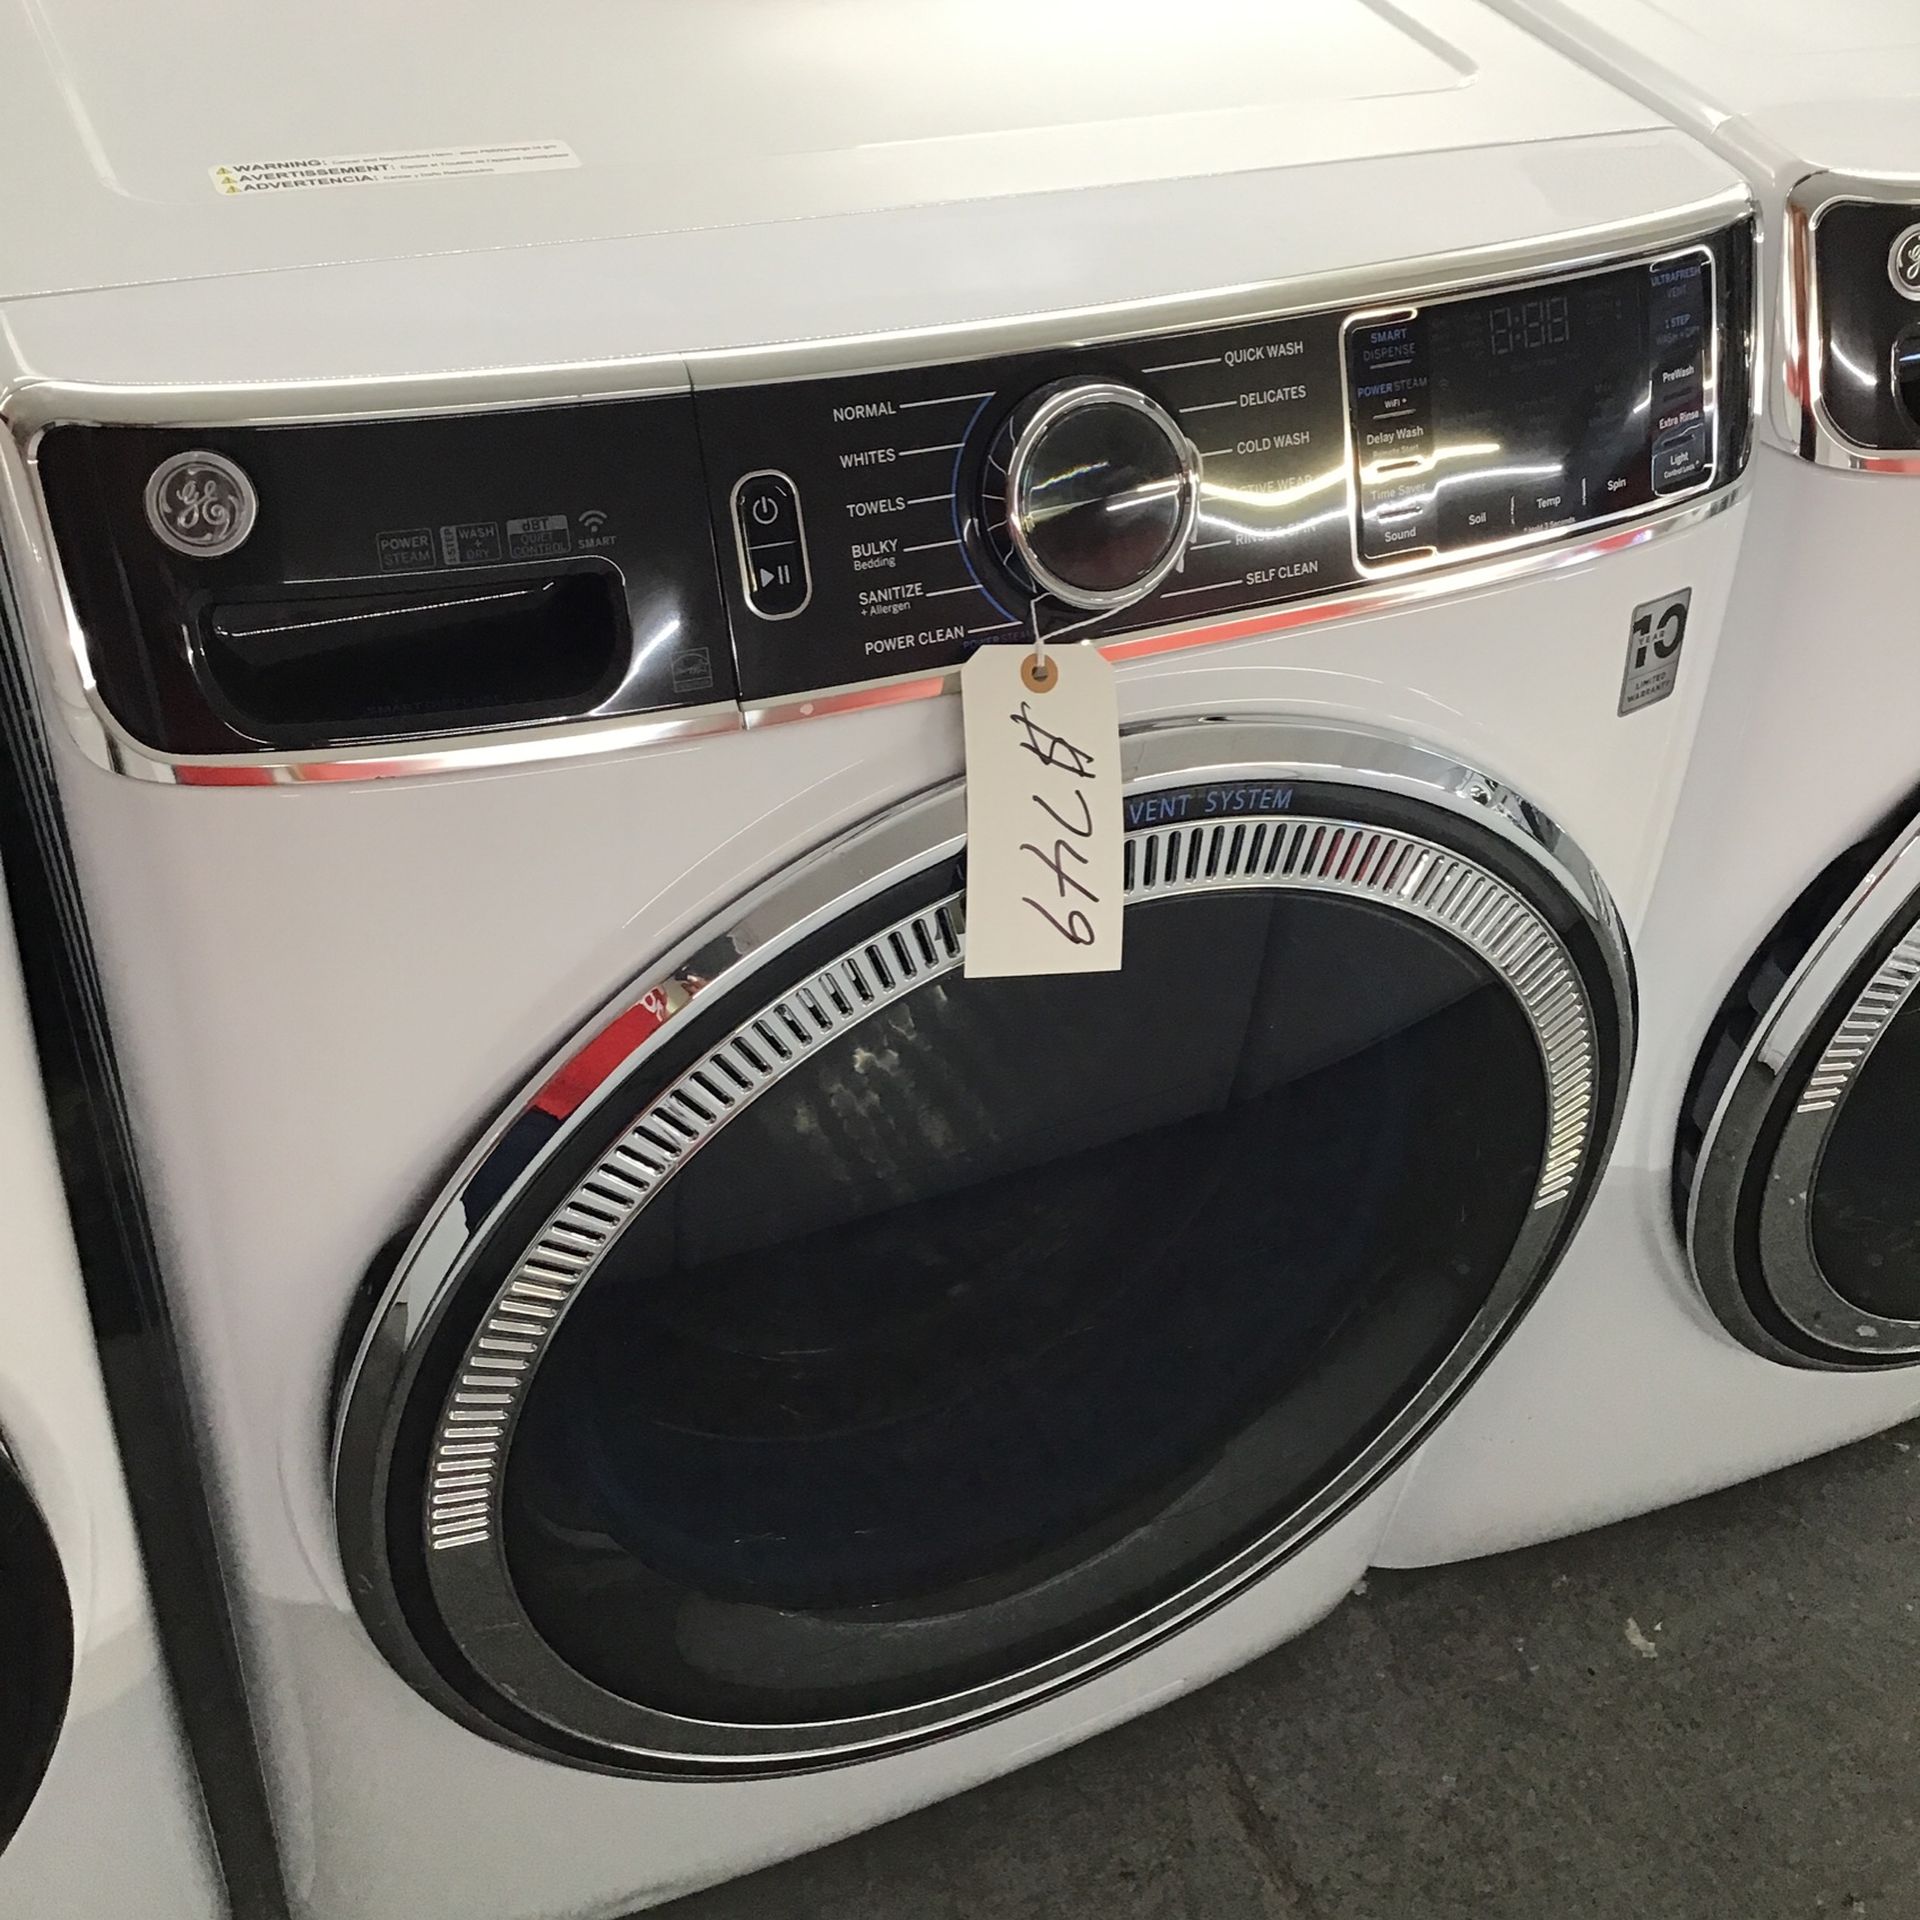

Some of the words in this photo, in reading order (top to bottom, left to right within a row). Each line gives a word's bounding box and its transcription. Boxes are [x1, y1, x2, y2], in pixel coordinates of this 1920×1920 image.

[233, 159, 327, 172] WARNING:
[239, 164, 395, 182] AVERTISSEMENT:
[244, 175, 378, 191] ADVERTENCIA:
[1370, 328, 1407, 344] SMART
[1224, 347, 1265, 367] QUICK
[1266, 341, 1304, 358] WASH
[1363, 343, 1416, 361] DISPENSE
[1239, 385, 1307, 407] DELICATES
[833, 401, 897, 422] NORMAL
[1659, 416, 1679, 430] Extra
[1237, 438, 1271, 455] COLD
[1273, 431, 1310, 449] WASH
[1367, 431, 1395, 445] Delay
[1397, 426, 1424, 440] Wash
[840, 448, 896, 469] WHITES
[1670, 451, 1689, 466] Light
[1607, 477, 1627, 491] Spin
[1371, 488, 1396, 501] Time
[1536, 496, 1561, 508] Temp
[846, 497, 906, 518] TOWELS
[1468, 512, 1487, 525] Soil
[459, 526, 495, 539] WASH
[1385, 527, 1416, 542] Sound
[380, 535, 429, 550] POWER
[578, 535, 617, 549] SMART
[852, 539, 898, 559] BULKY
[383, 550, 431, 566] STEAM
[854, 556, 896, 571] Bedding
[1246, 568, 1275, 585] SELF
[1278, 561, 1318, 580] CLEAN
[858, 583, 924, 606] SANITIZE
[870, 601, 911, 617] Allergen
[865, 636, 915, 655] POWER
[919, 626, 965, 647] CLEAN
[1633, 603, 1687, 669] 10
[1129, 794, 1191, 824] VENT
[1204, 788, 1295, 814] SYSTEM
